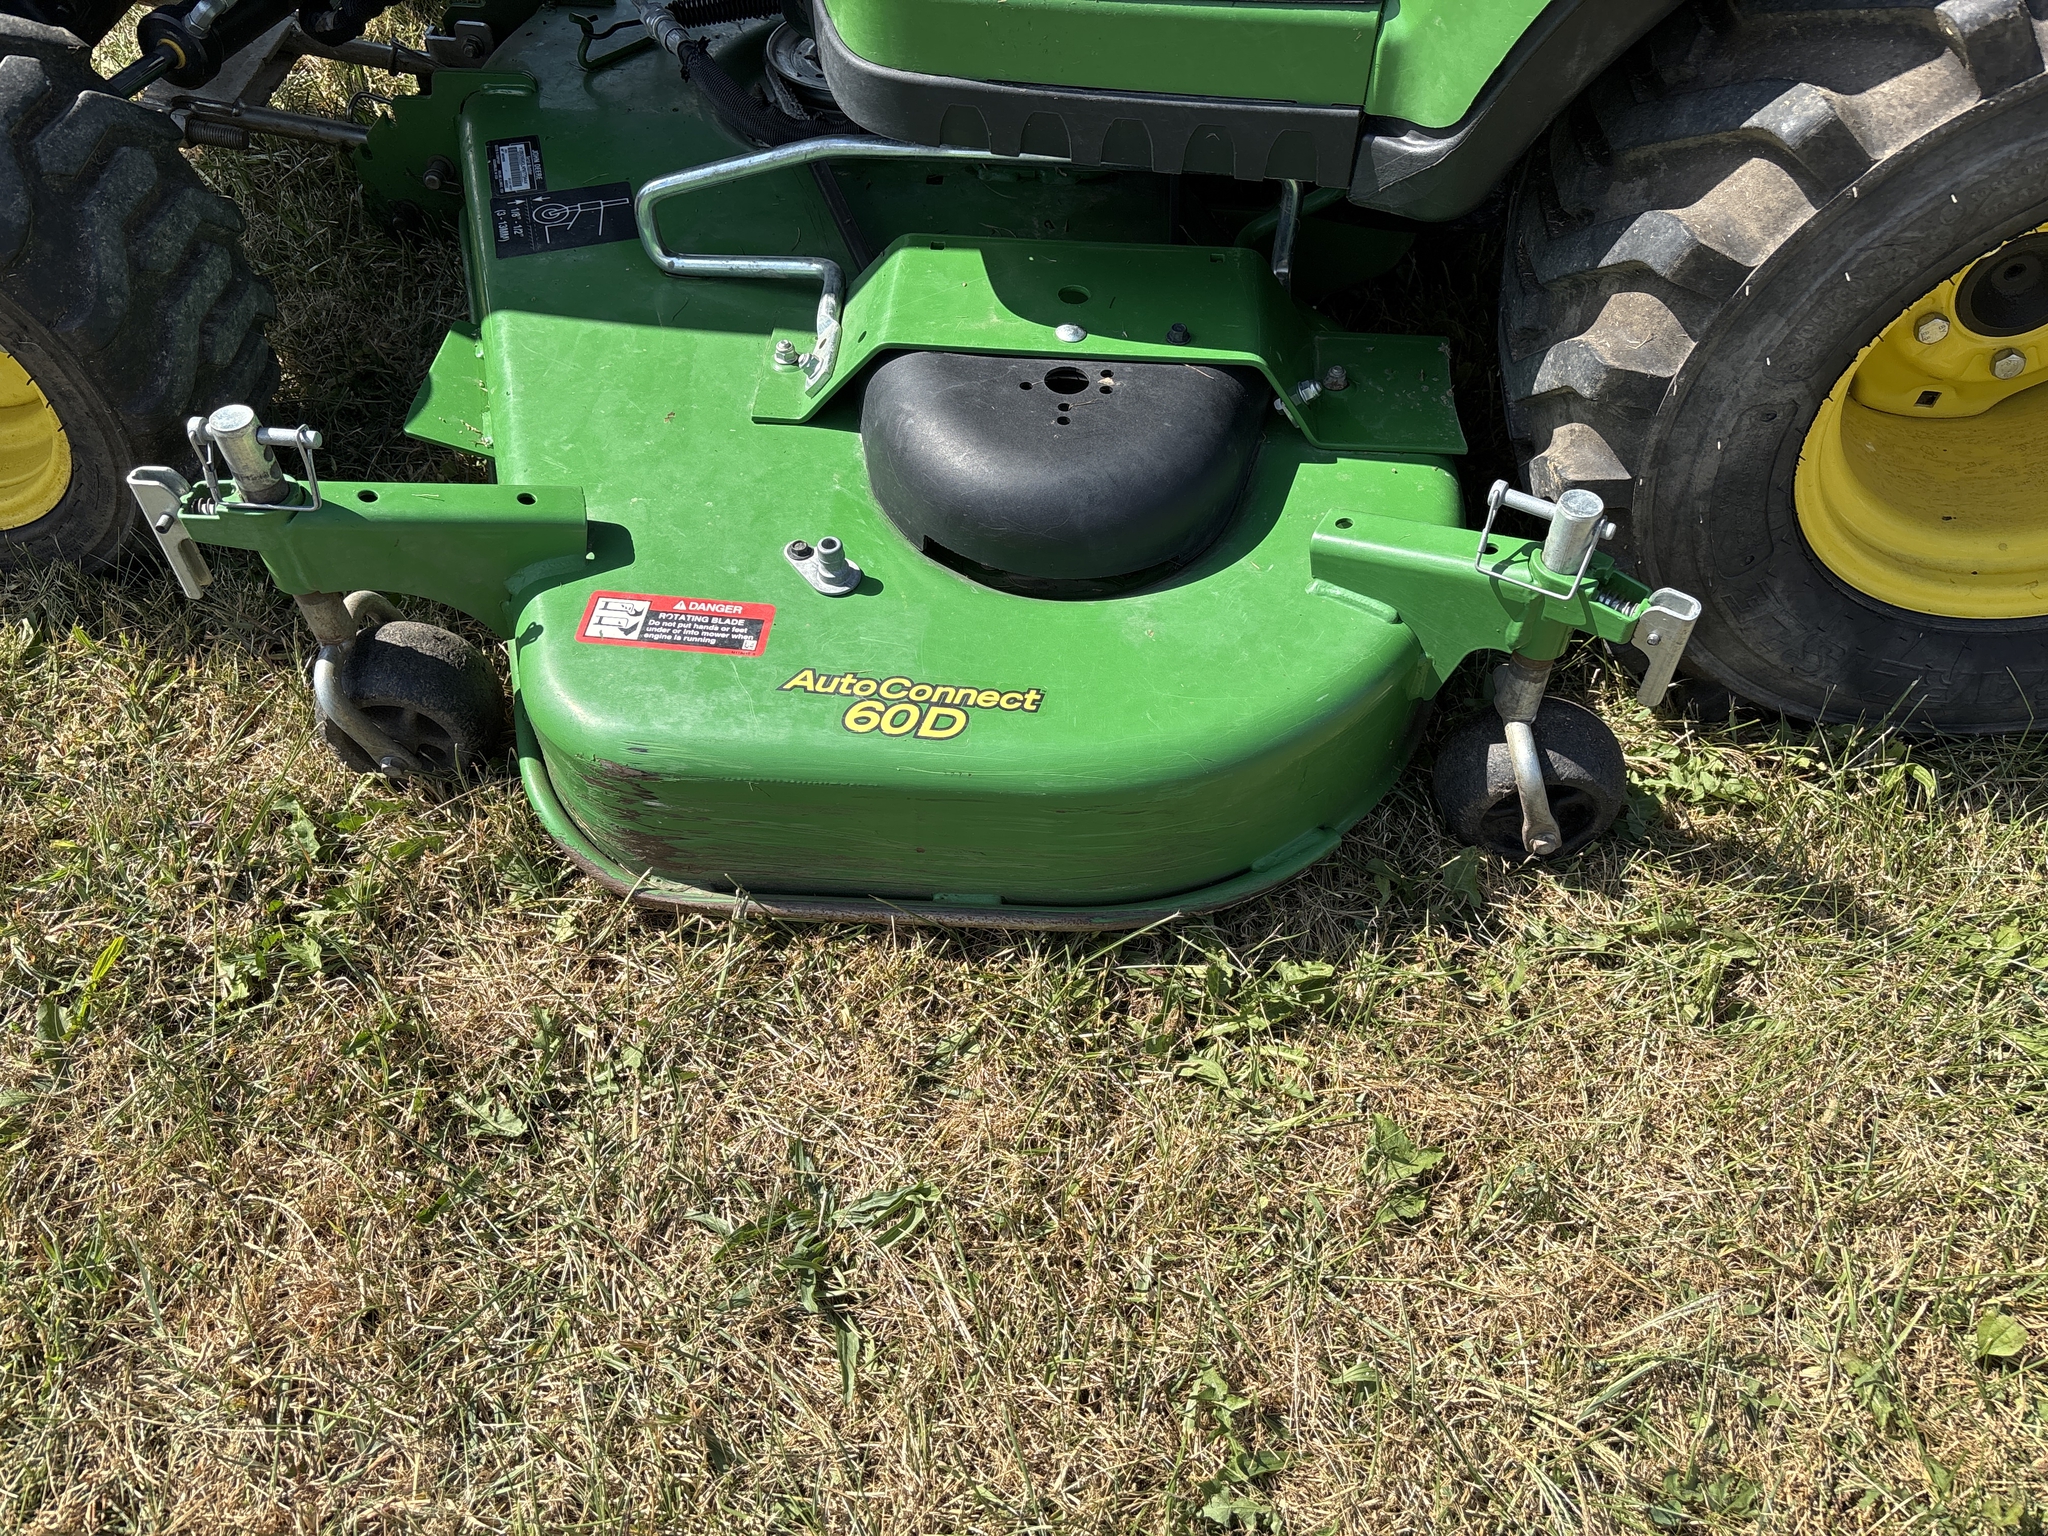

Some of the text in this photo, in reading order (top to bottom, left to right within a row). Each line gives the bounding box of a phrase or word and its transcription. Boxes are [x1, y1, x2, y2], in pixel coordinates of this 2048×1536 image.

[534, 164, 543, 180] DEERE
[497, 221, 510, 242] 13MM)
[513, 224, 525, 237] 1/2"
[688, 602, 743, 614] DANGER
[658, 612, 745, 626] ROTATING BLADE
[683, 628, 700, 636] into
[731, 632, 754, 640] when
[692, 623, 719, 632] hands
[731, 626, 749, 634] feet
[644, 633, 672, 641] engine
[683, 636, 717, 645] running
[778, 668, 1045, 713] AutoConnect
[842, 699, 969, 741] 60D
